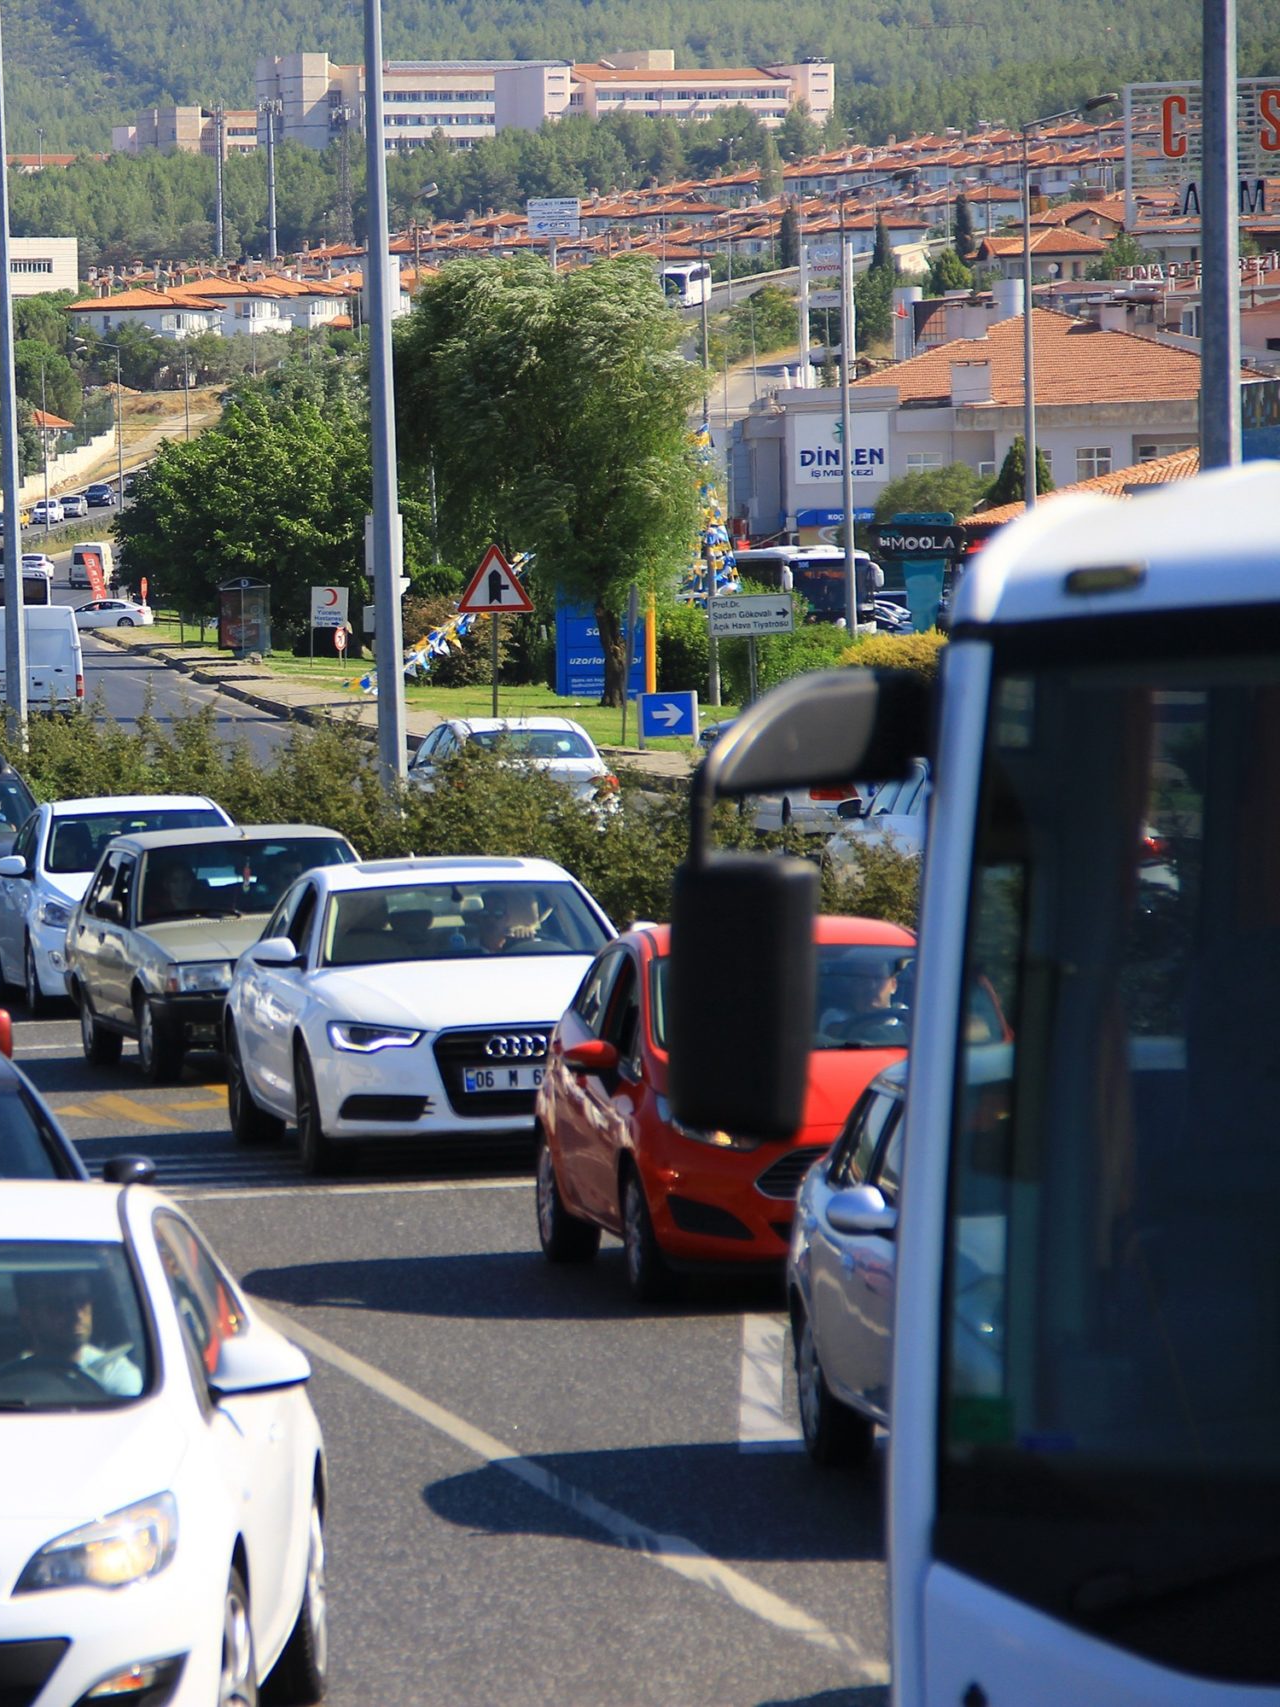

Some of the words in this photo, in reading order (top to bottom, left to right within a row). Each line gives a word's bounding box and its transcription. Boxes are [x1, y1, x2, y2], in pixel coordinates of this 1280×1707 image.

[813, 264, 841, 272] TOYOTA
[1115, 264, 1163, 281] TUNA
[800, 446, 885, 466] DİNEN
[241, 579, 249, 587] D
[732, 622, 751, 630] Hava
[476, 1071, 494, 1088] 06
